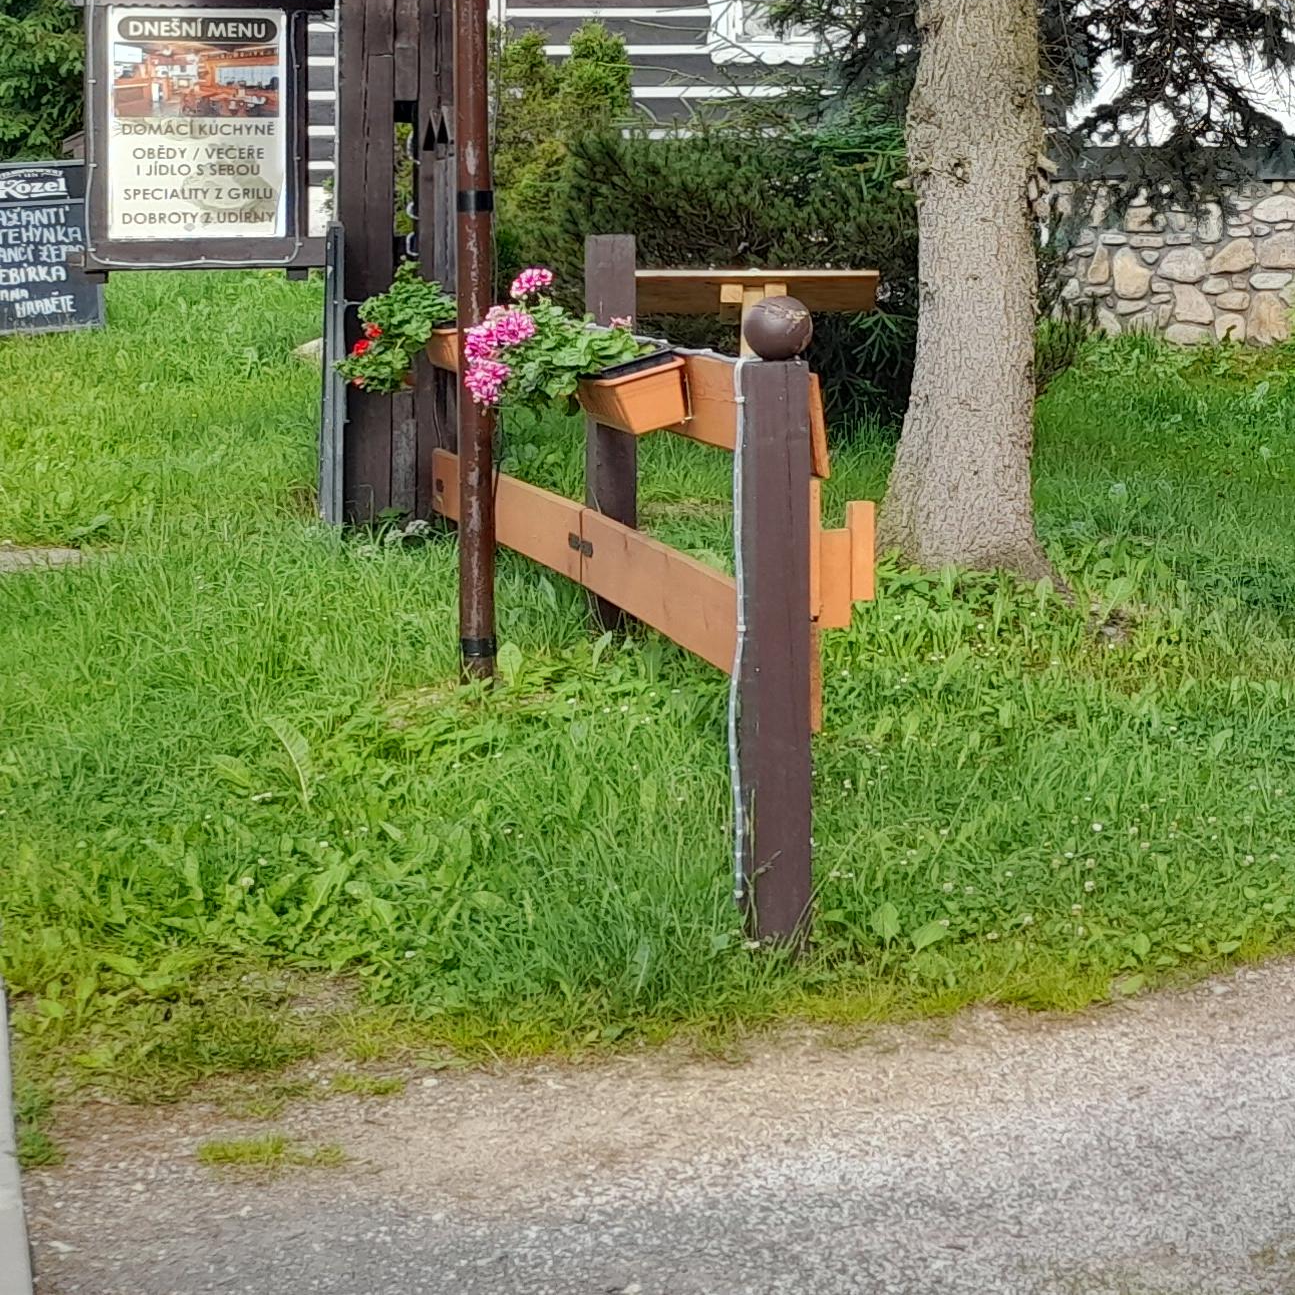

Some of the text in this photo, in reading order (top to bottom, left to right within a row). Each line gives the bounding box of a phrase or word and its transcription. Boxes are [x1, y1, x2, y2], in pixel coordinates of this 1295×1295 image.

[129, 17, 266, 38] DNEŠNÍ MENU
[122, 118, 194, 136] DOMÁCÍ
[132, 145, 187, 160] OBĚDY
[205, 145, 265, 160] VEČEŘE
[146, 161, 191, 176] JÍDLO
[196, 164, 204, 176] S
[209, 164, 261, 176] SEBOU
[0, 178, 68, 199] Kozel
[123, 188, 273, 201] SPECIALITY Z GRILU
[122, 208, 275, 225] DOBROTY Z UDÍRNY
